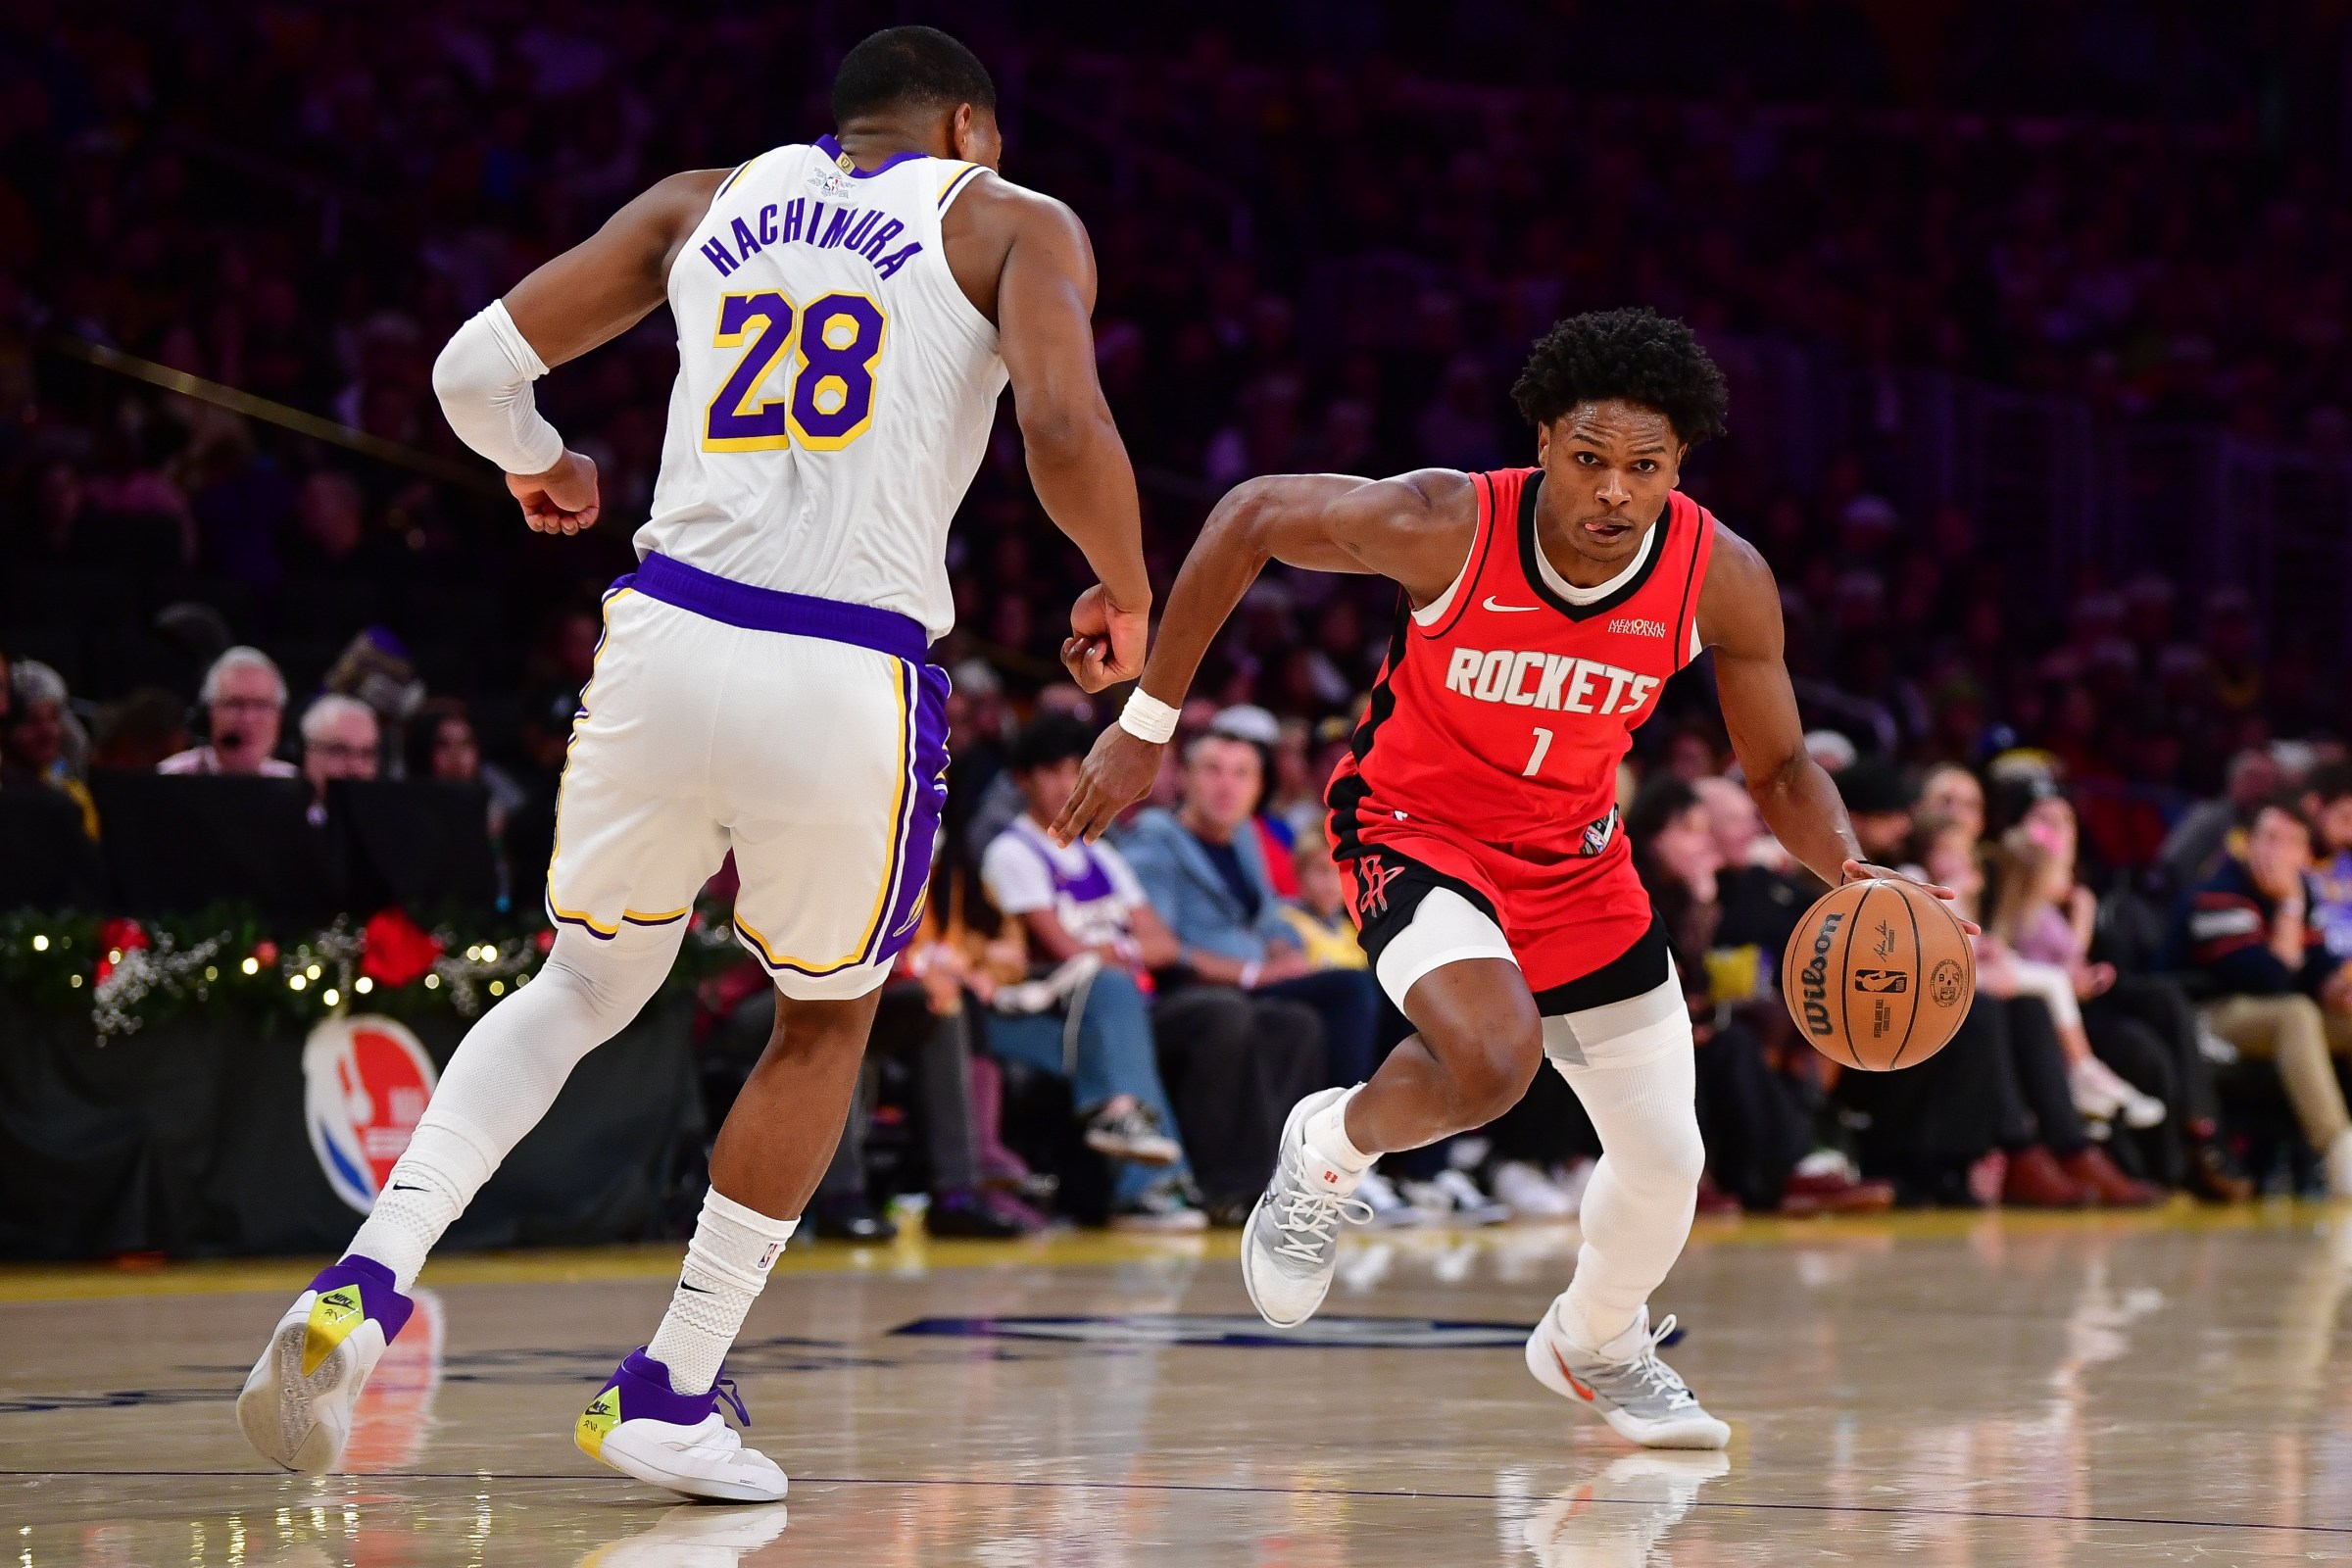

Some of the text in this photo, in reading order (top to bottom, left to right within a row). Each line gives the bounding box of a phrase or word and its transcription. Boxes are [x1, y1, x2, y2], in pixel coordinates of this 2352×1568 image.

[700, 198, 923, 281] HACHIMURA
[702, 288, 889, 453] 28
[1607, 624, 1667, 639] HERMANN
[1609, 618, 1666, 632] MEMORIAL
[1445, 647, 1661, 715] ROCKETS
[1522, 727, 1554, 776] 1
[1800, 912, 1845, 1037] Wilson
[331, 1293, 356, 1306] NIKE
